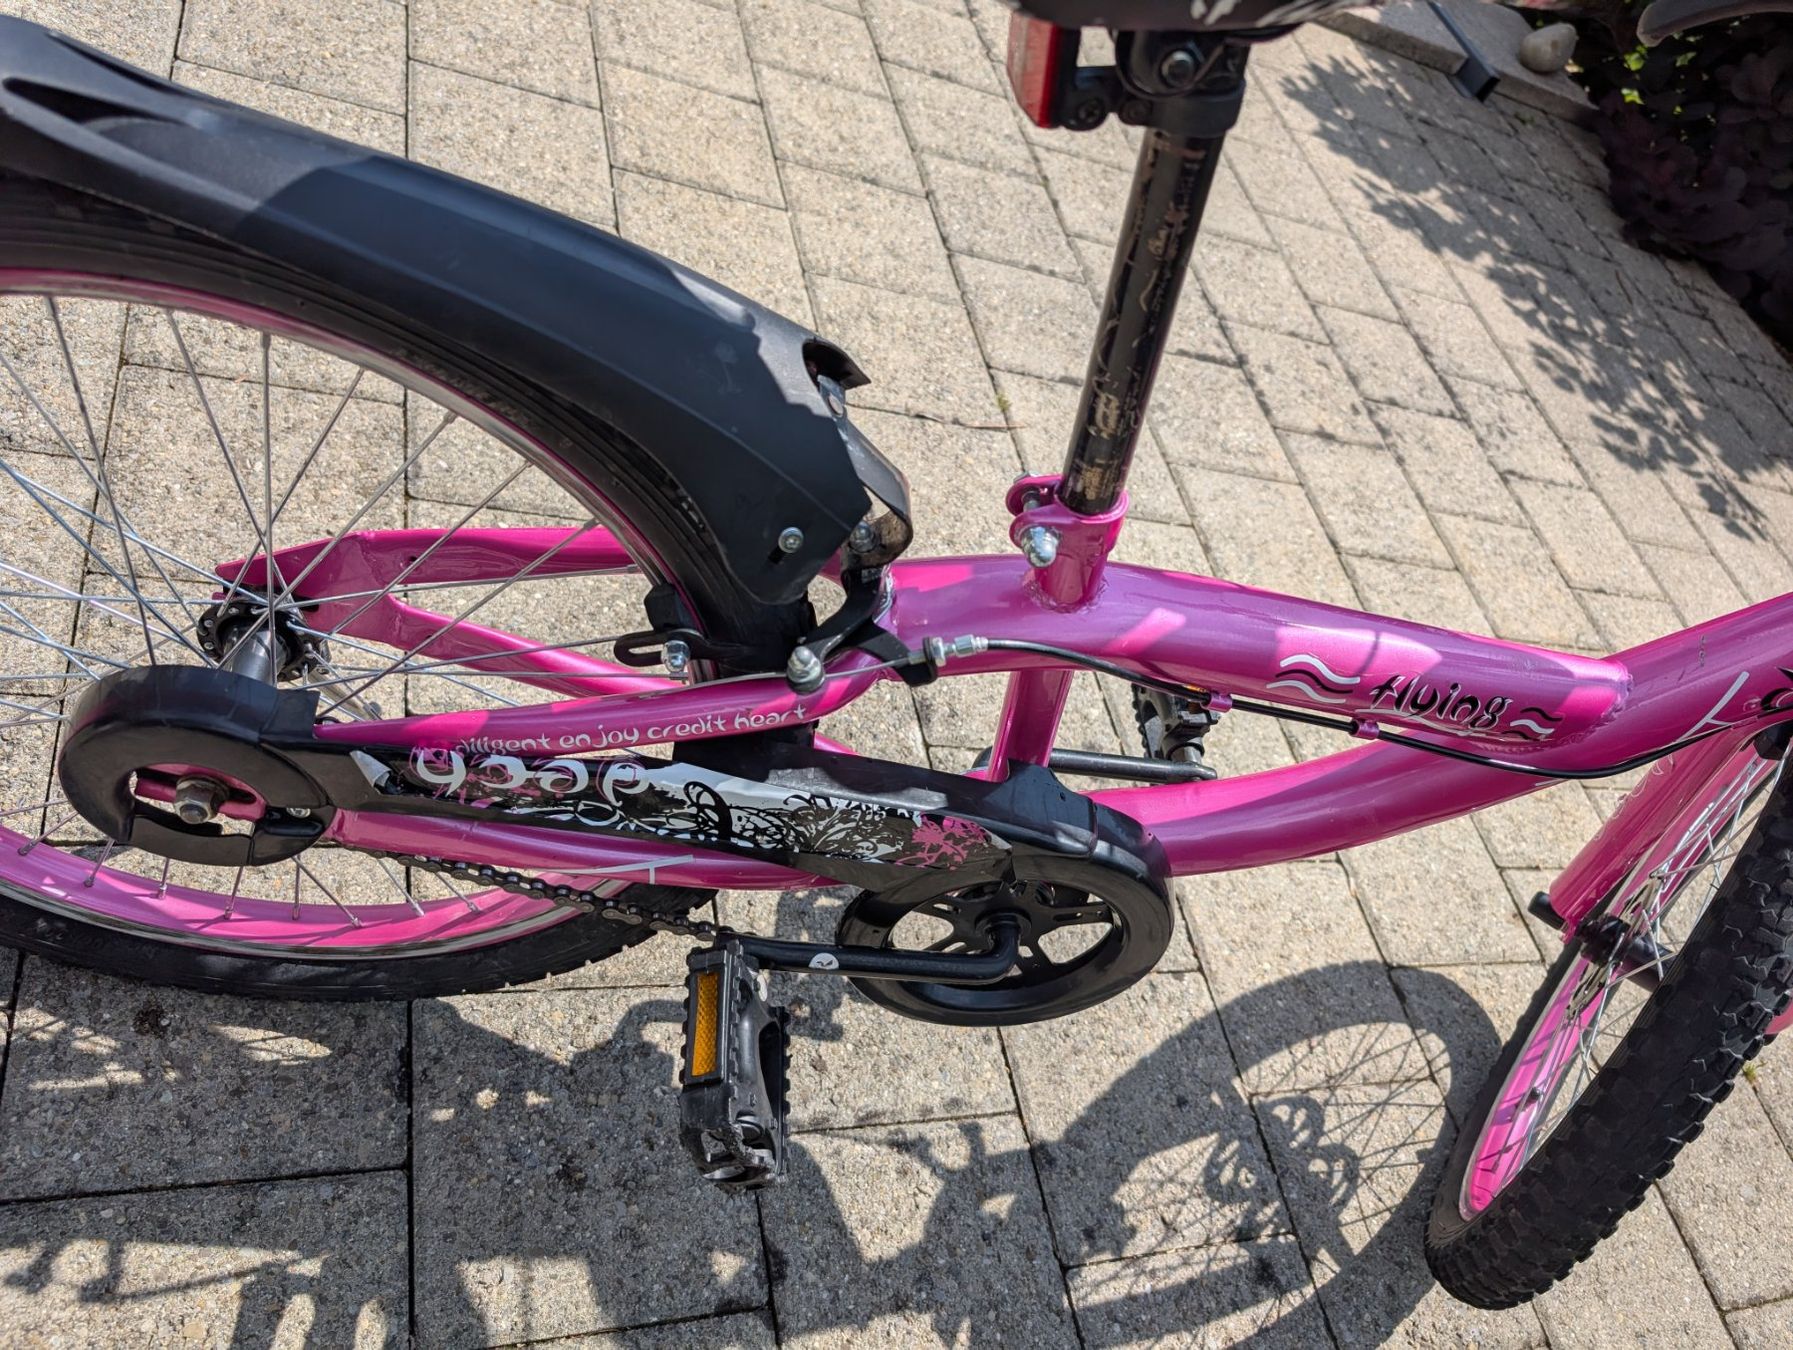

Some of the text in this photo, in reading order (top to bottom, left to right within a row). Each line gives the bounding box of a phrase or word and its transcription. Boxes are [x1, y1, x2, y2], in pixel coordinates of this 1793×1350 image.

[455, 703, 806, 756] diligent enjoy credit heart
